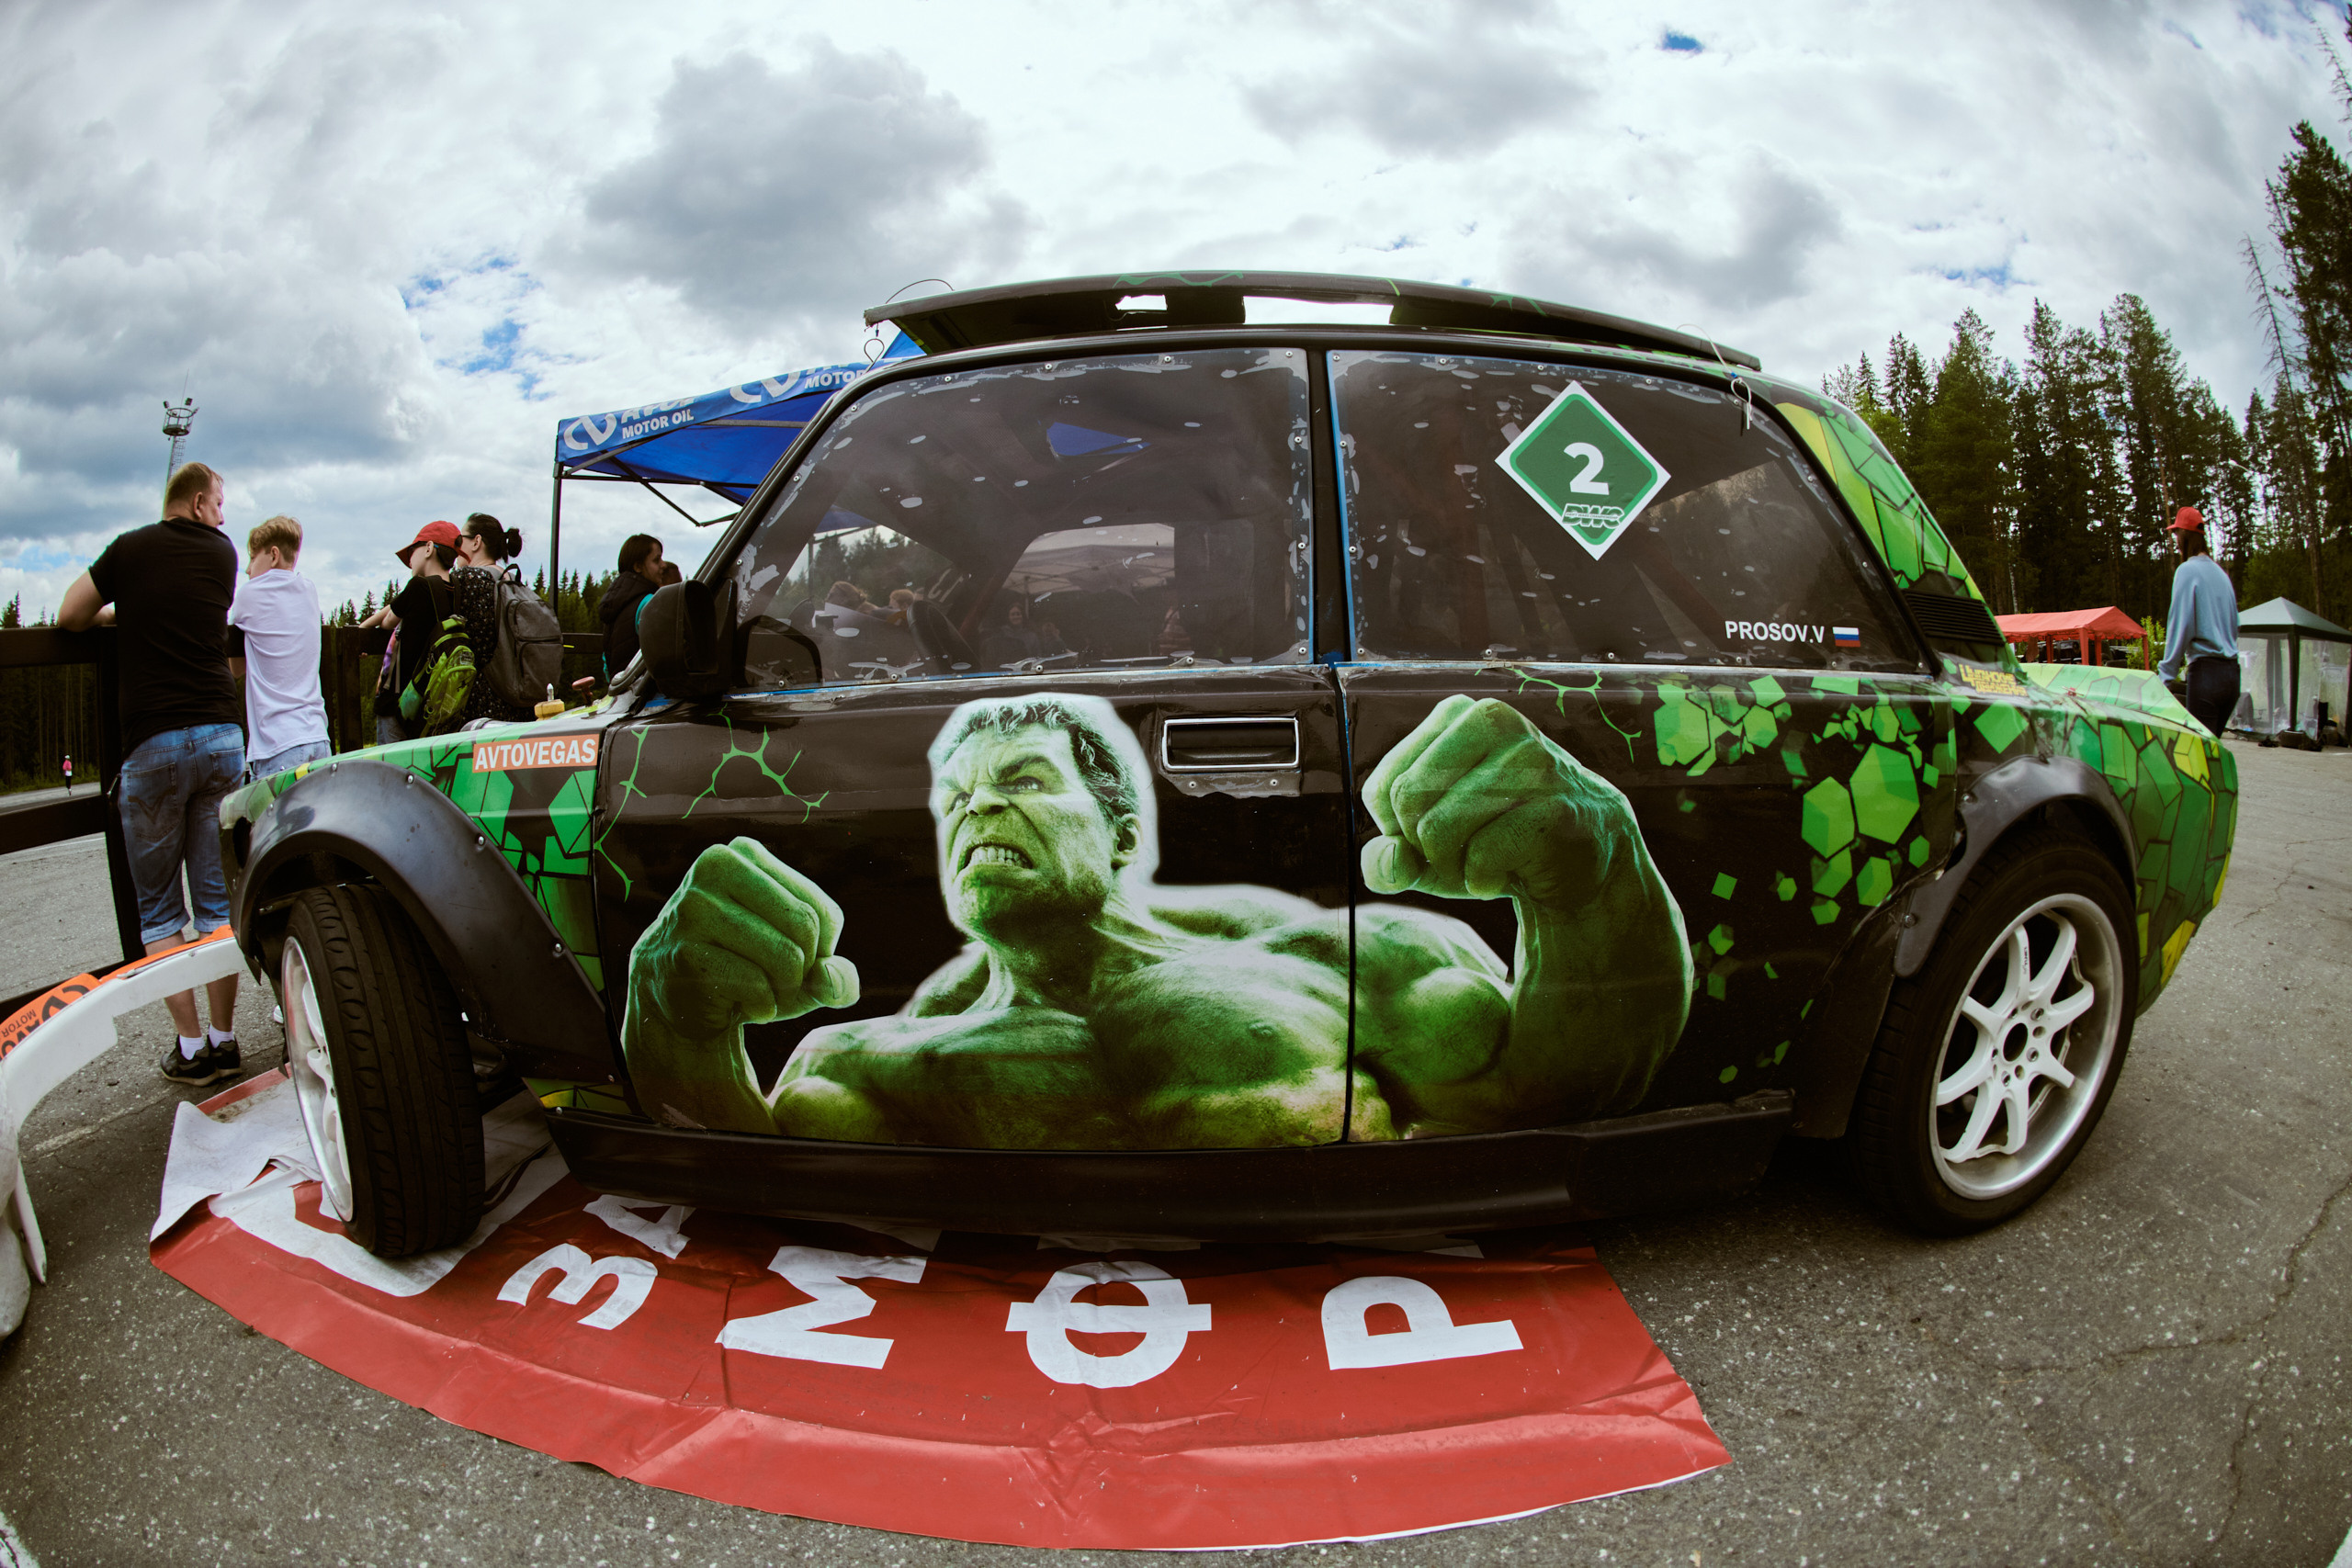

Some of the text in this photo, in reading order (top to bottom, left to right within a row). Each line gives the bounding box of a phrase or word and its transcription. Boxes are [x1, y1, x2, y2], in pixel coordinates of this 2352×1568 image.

[622, 415, 669, 439] MOTOR
[672, 409, 695, 424] OIL
[1564, 442, 1610, 495] 2
[1562, 502, 1624, 529] DWC
[1724, 620, 1825, 644] PROSOV.V
[475, 739, 596, 770] AVTOVEGAS
[2, 1009, 36, 1038] MOTOR
